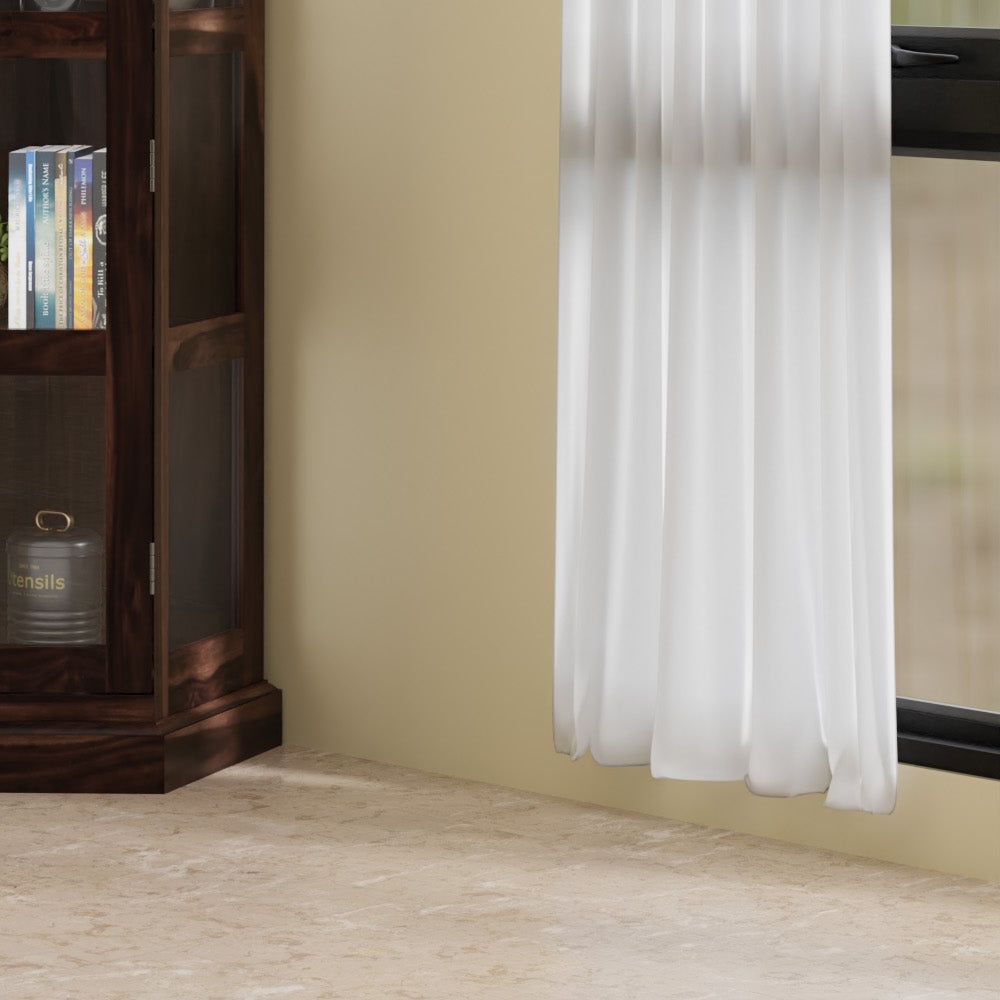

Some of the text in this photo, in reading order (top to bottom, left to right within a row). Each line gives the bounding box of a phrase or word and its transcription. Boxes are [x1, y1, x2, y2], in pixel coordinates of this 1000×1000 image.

[42, 163, 50, 225] AUTHOR'S NAME
[97, 287, 104, 298] To
